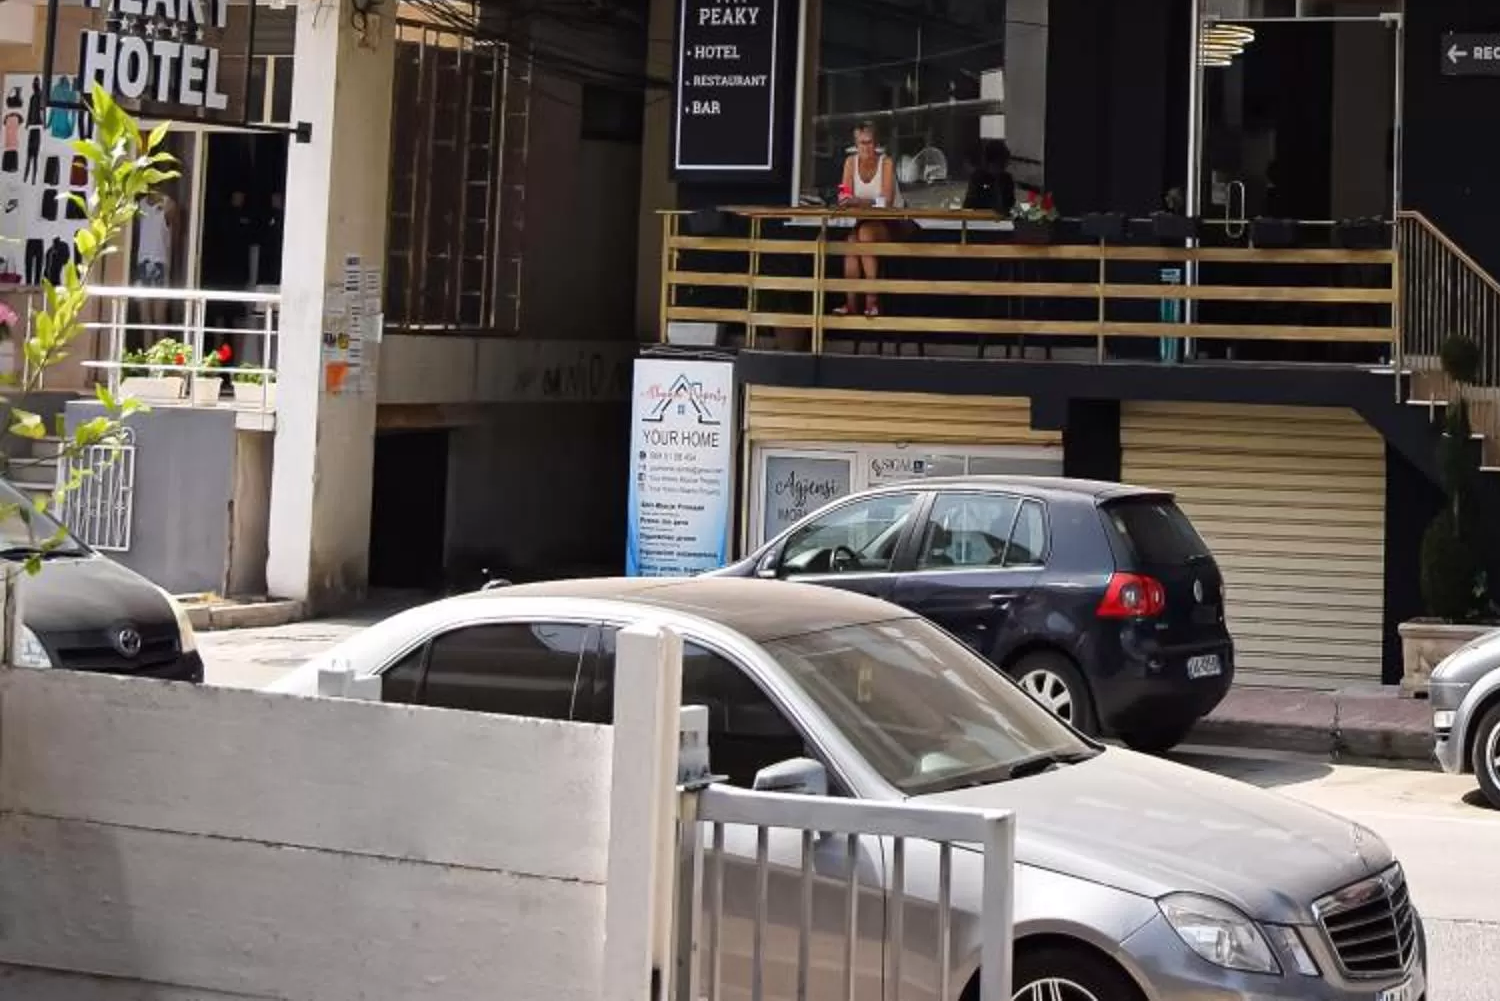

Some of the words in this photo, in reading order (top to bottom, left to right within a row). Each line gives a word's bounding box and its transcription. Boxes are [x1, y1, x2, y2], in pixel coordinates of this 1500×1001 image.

[699, 7, 760, 26] PEAKY
[694, 45, 741, 60] HOTEL
[81, 30, 228, 110] HOTEL
[693, 74, 768, 87] RESTAURANT
[692, 100, 720, 114] BAR
[643, 430, 679, 446] YOUR
[682, 431, 720, 448] HOME
